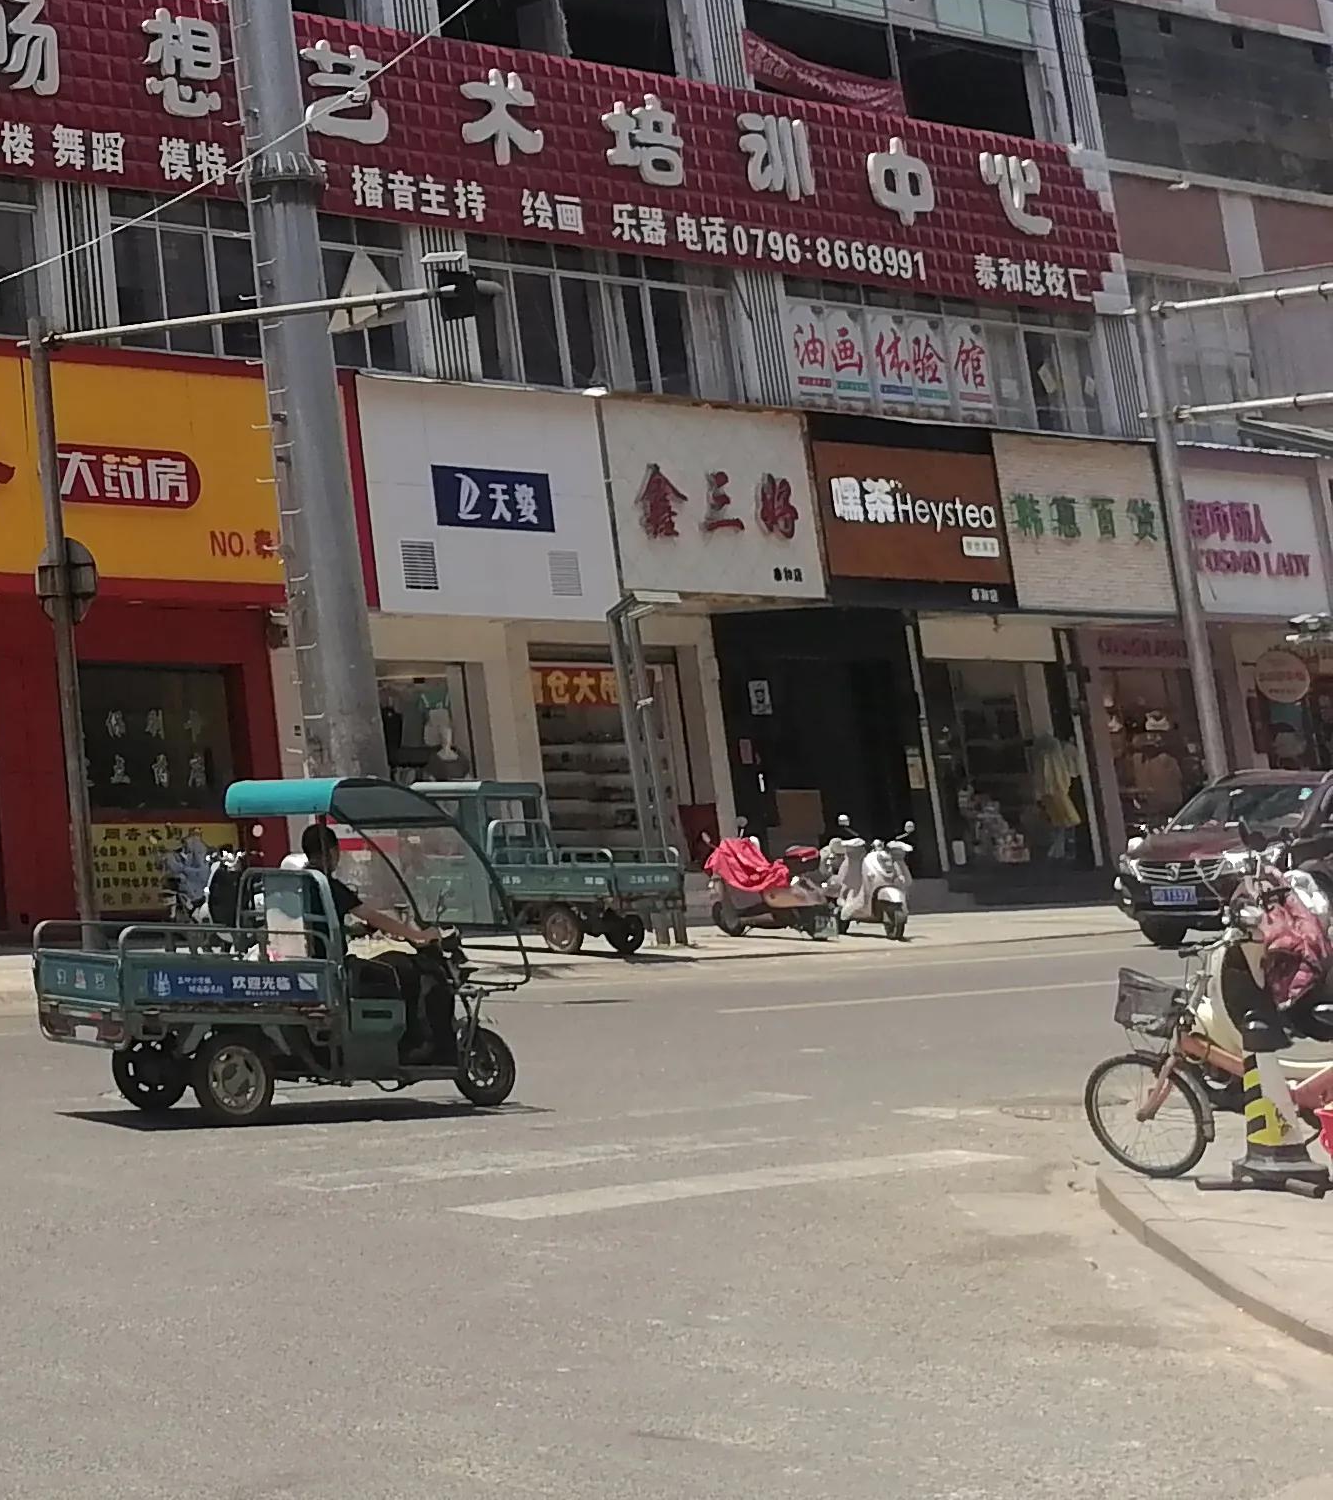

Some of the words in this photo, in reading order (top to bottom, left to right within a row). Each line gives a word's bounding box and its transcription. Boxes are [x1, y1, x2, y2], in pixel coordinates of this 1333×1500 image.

[51, 123, 125, 175] 舞蹈
[158, 136, 227, 186] 模特
[350, 165, 487, 224] 播音主持
[521, 188, 585, 235] 绘画
[611, 203, 667, 247] 乐器
[794, 322, 988, 390] 油画体验馆
[57, 450, 190, 503] 大药房
[488, 483, 540, 525] 天姿
[896, 492, 997, 533] Heystea
[1263, 551, 1311, 577] LADY
[231, 975, 292, 991] 欢迎光临
